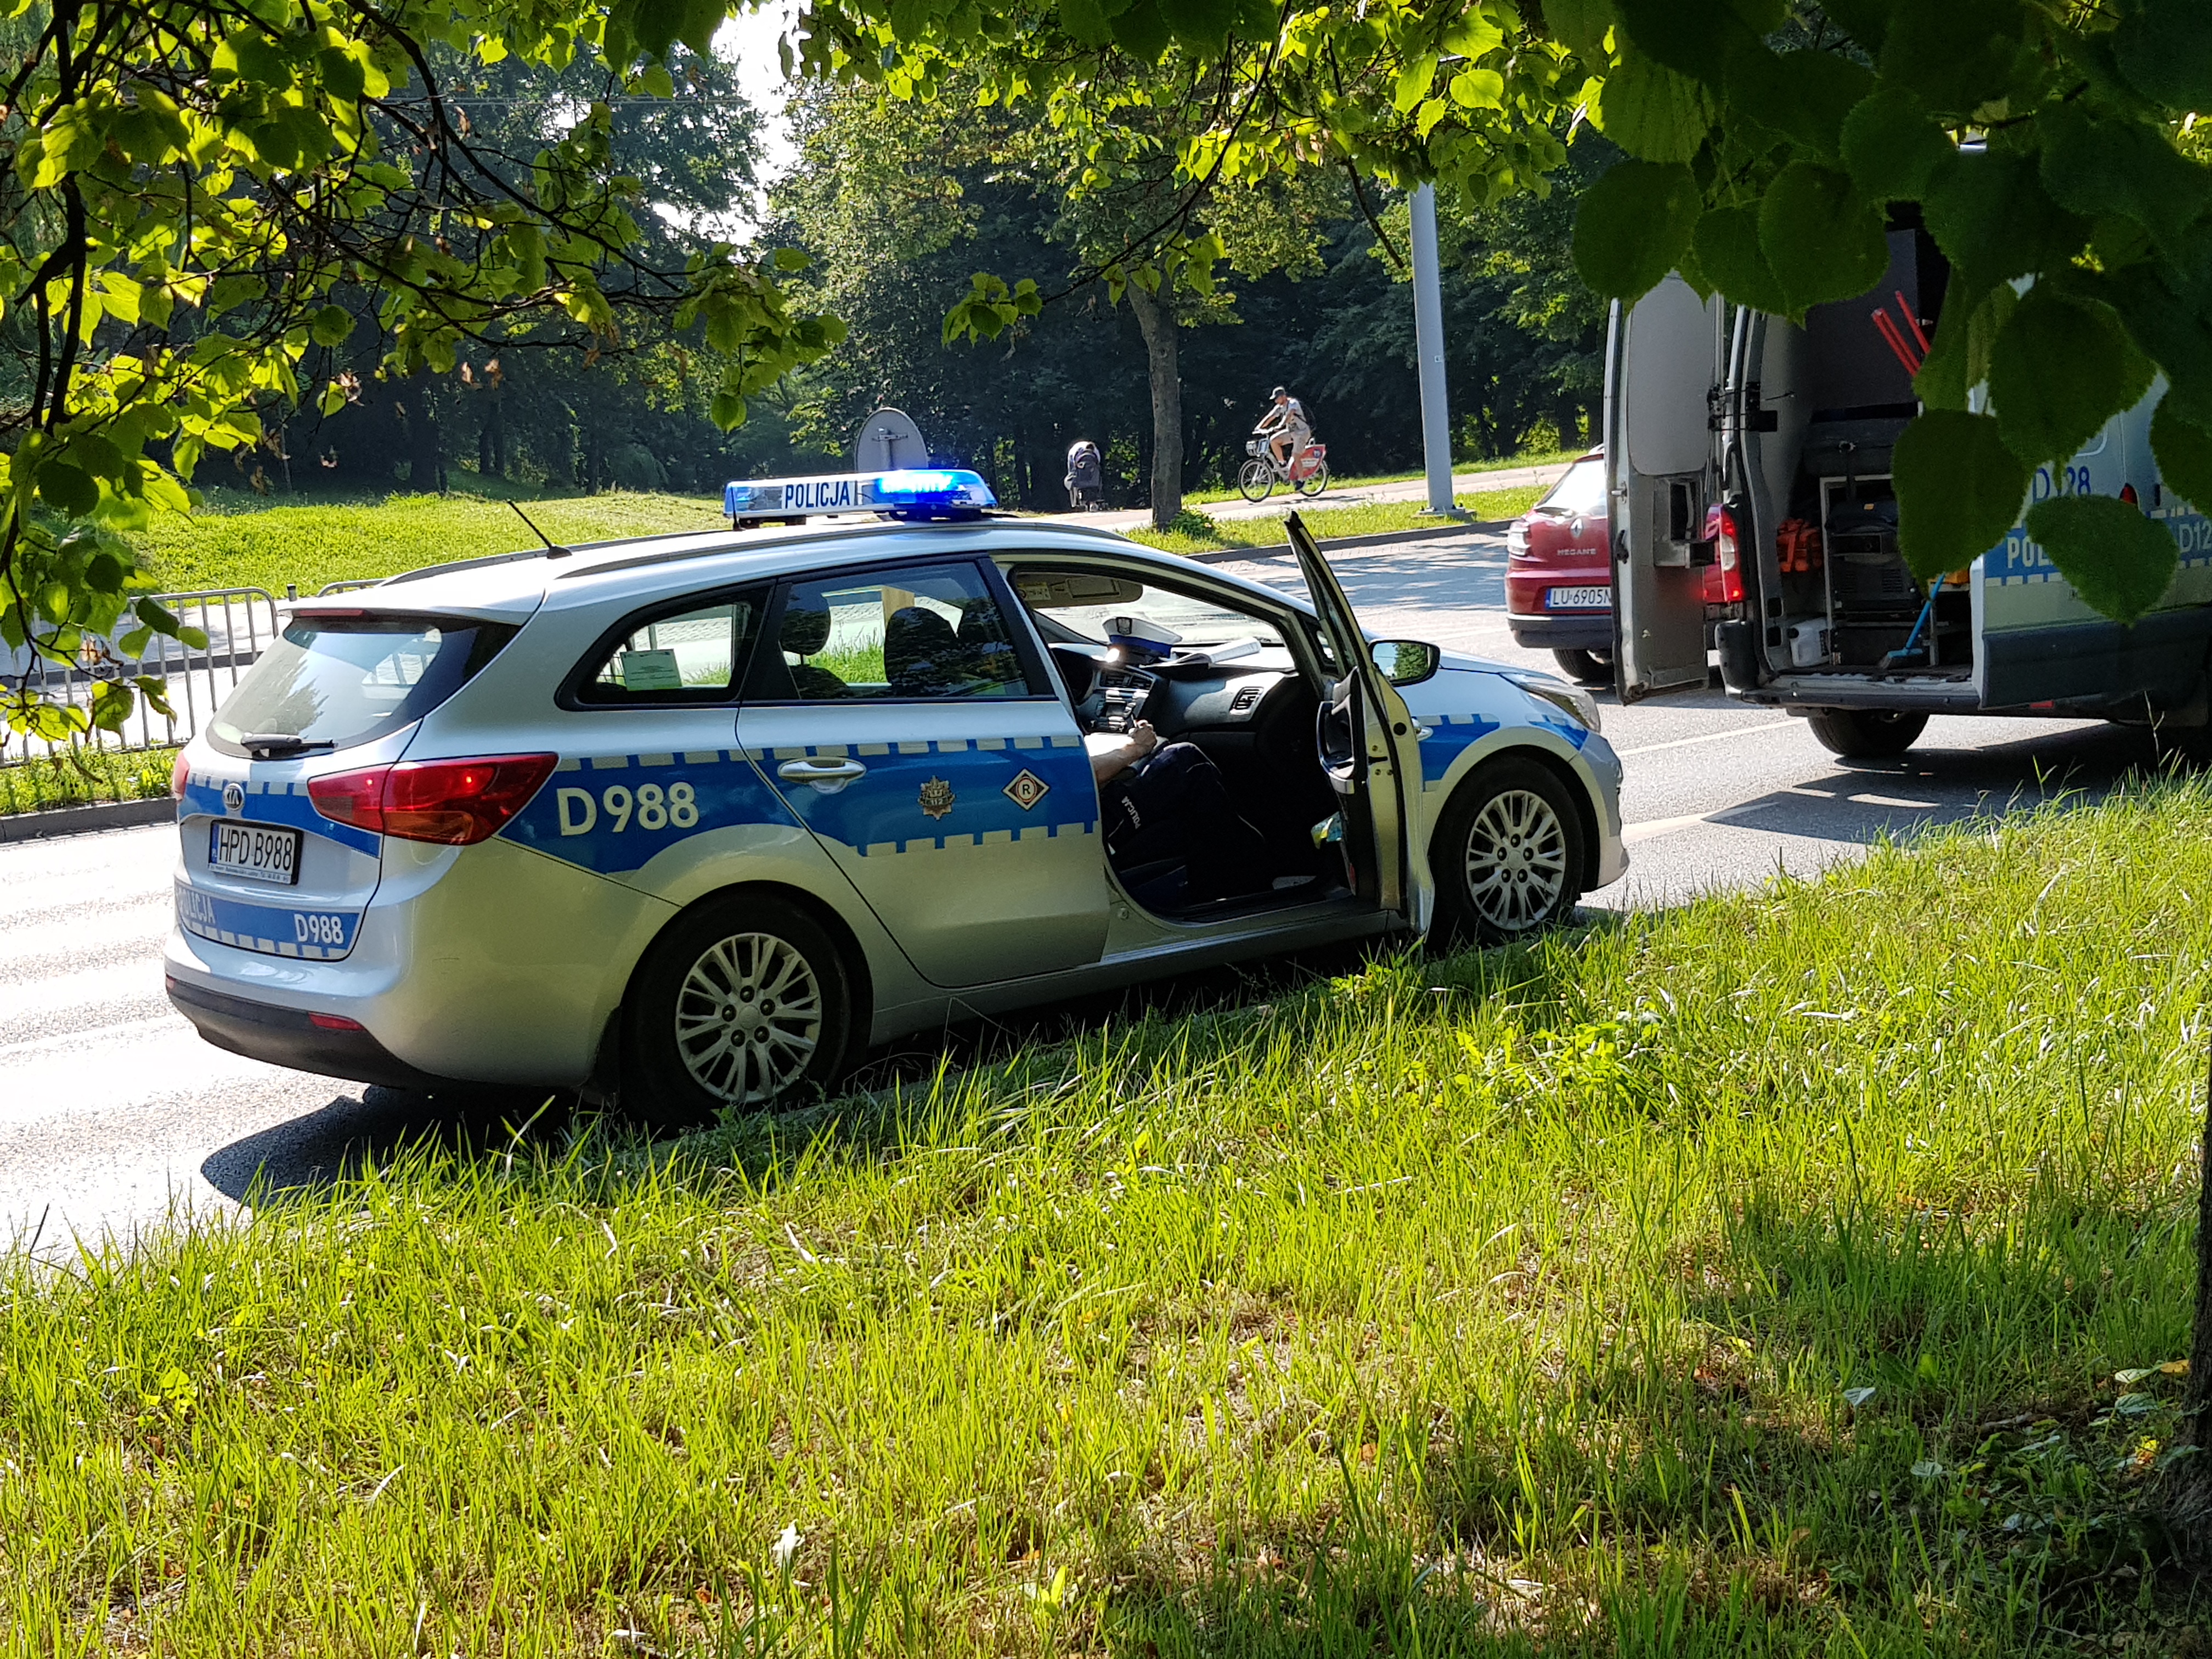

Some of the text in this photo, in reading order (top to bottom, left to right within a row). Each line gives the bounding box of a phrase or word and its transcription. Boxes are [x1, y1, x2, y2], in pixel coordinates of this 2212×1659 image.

[785, 481, 850, 509] POLICJA
[1553, 590, 1570, 605] LU
[224, 789, 239, 805] KIA
[1022, 784, 1030, 795] R
[556, 781, 699, 837] D988
[1121, 795, 1142, 830] POLICJA
[219, 827, 293, 871] HPD B988
[294, 913, 344, 944] D988
